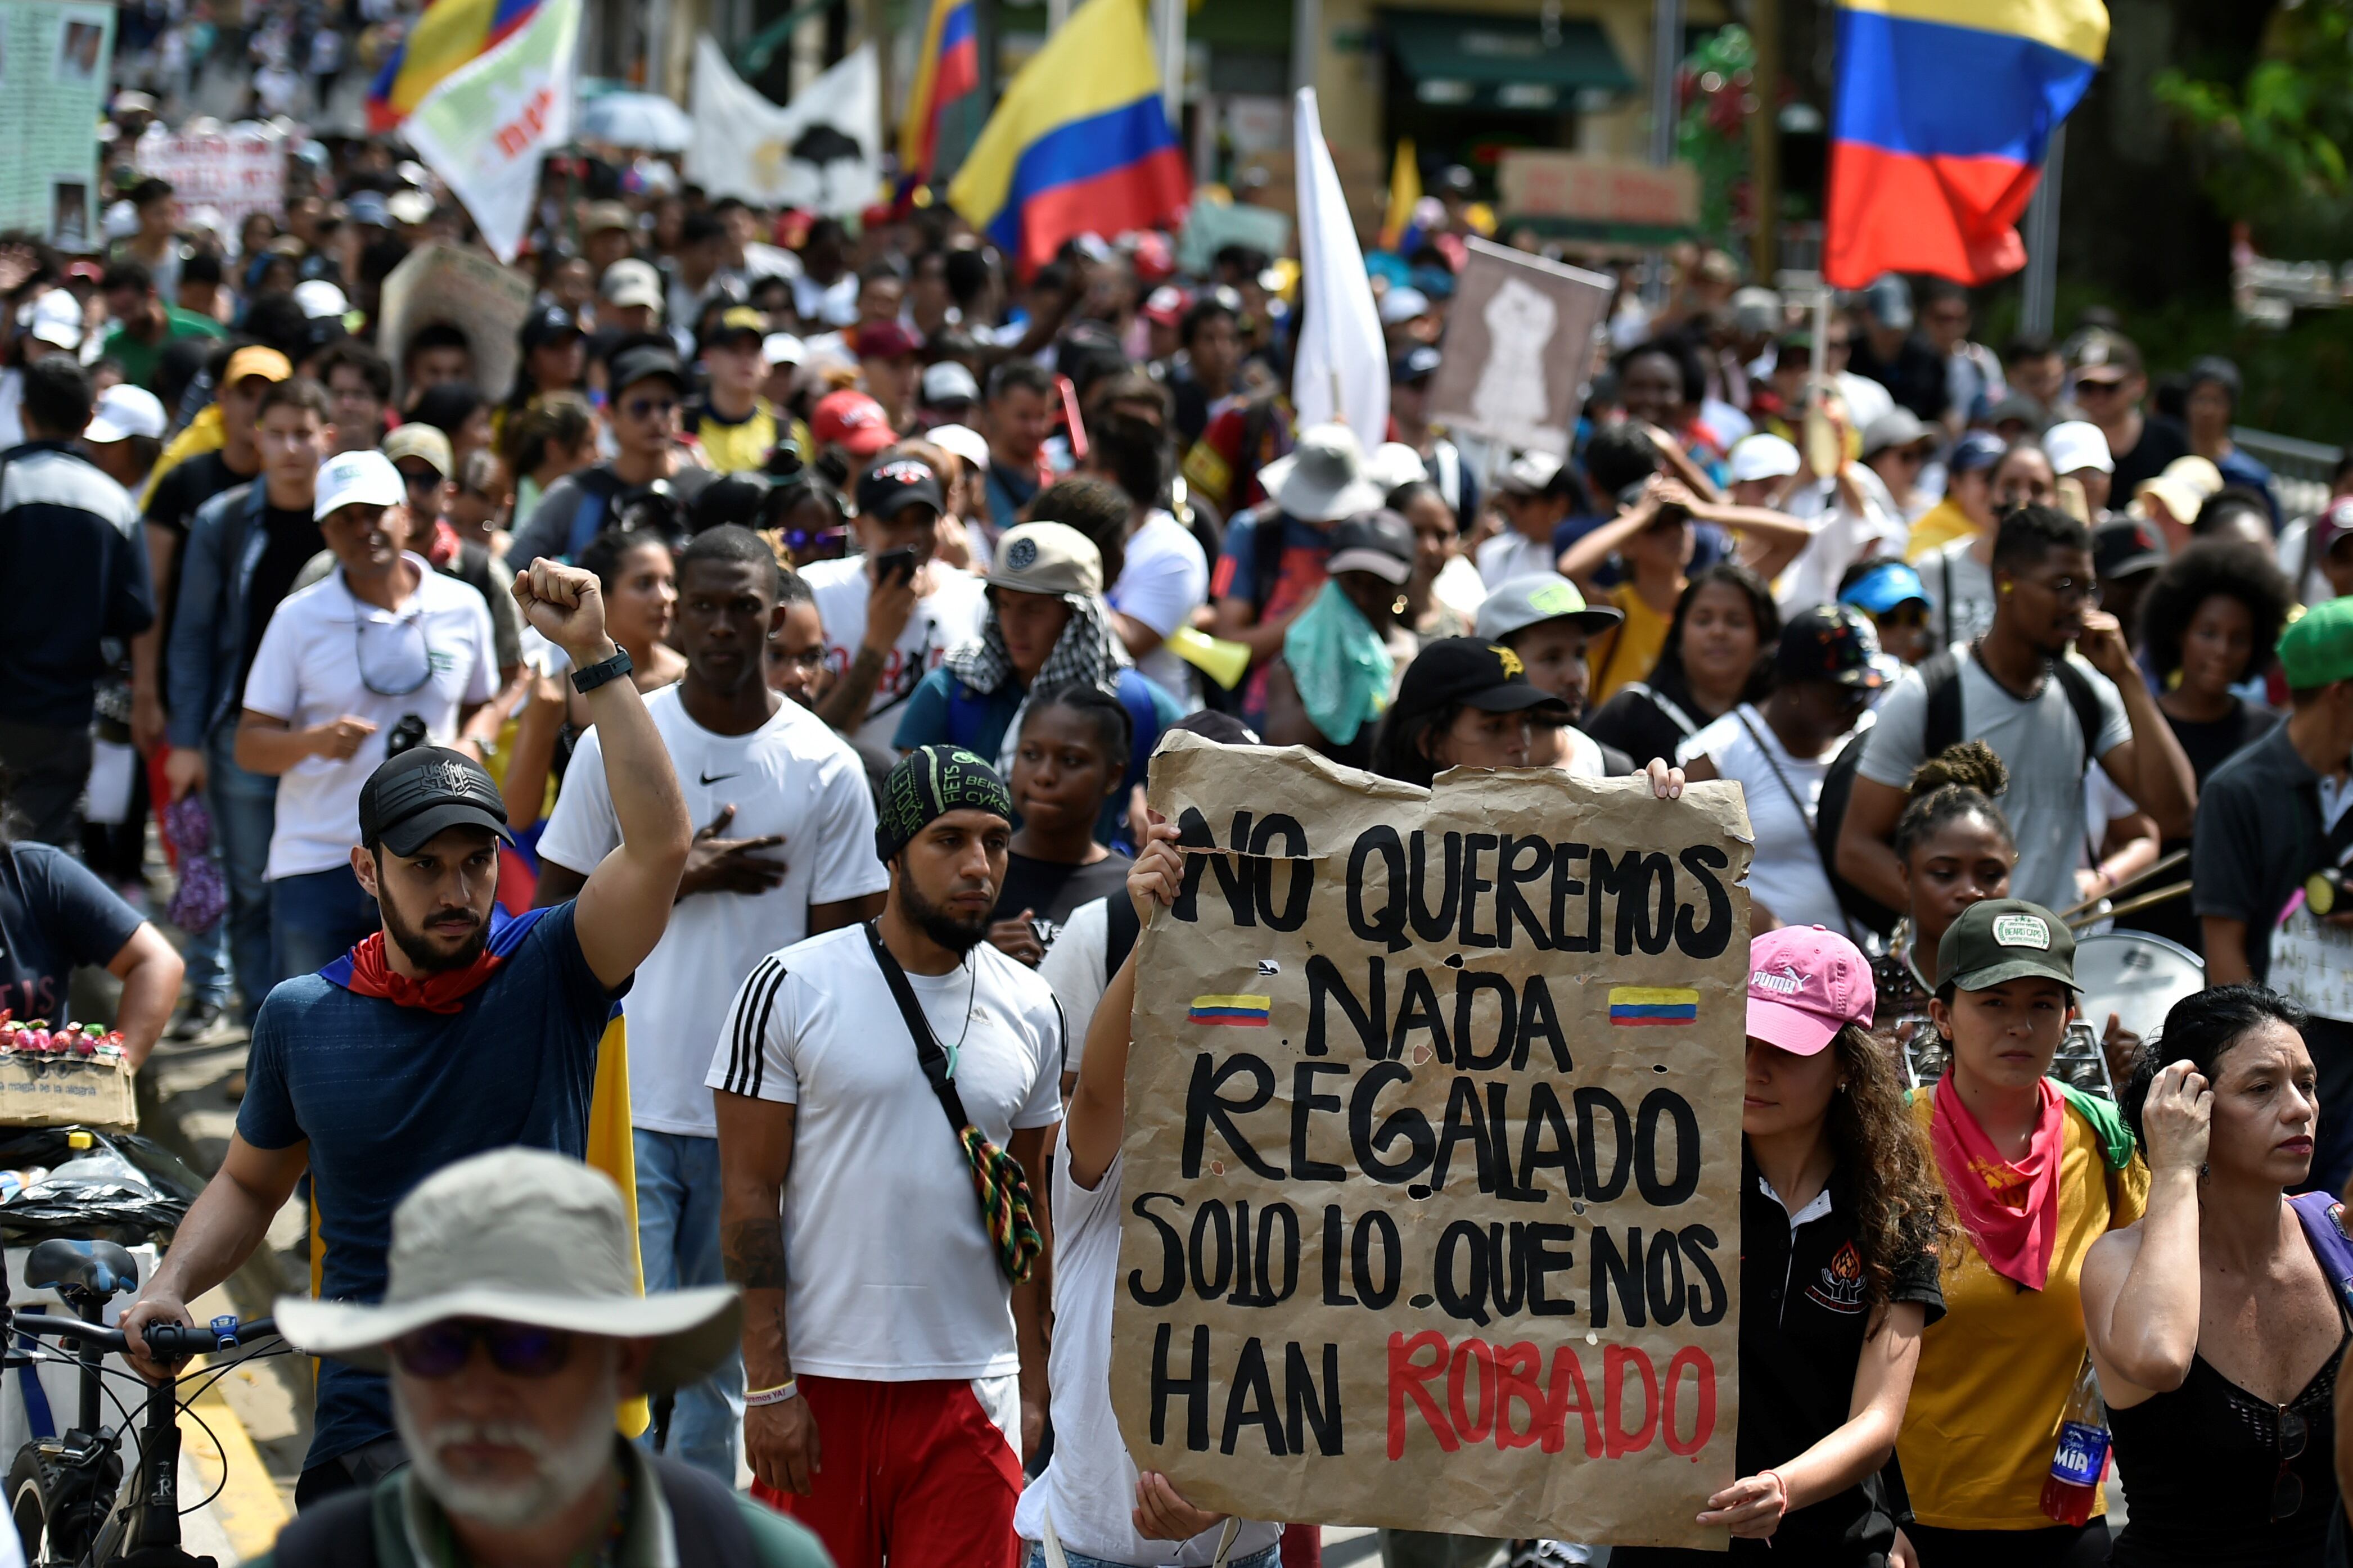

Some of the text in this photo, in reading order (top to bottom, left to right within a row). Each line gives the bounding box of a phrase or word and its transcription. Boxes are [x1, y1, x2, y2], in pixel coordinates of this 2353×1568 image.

[944, 765, 961, 803] FIETS
[965, 775, 1000, 794] BEIC
[1171, 807, 1732, 959] NO QUEREMOS
[1305, 954, 1572, 1073] NADA
[1751, 971, 1796, 995] PUMA
[1182, 1052, 1701, 1206] REGALADO
[1128, 1192, 1728, 1328] SOLO LO QUE NOS
[1150, 1323, 1716, 1461] HAN ROBADO
